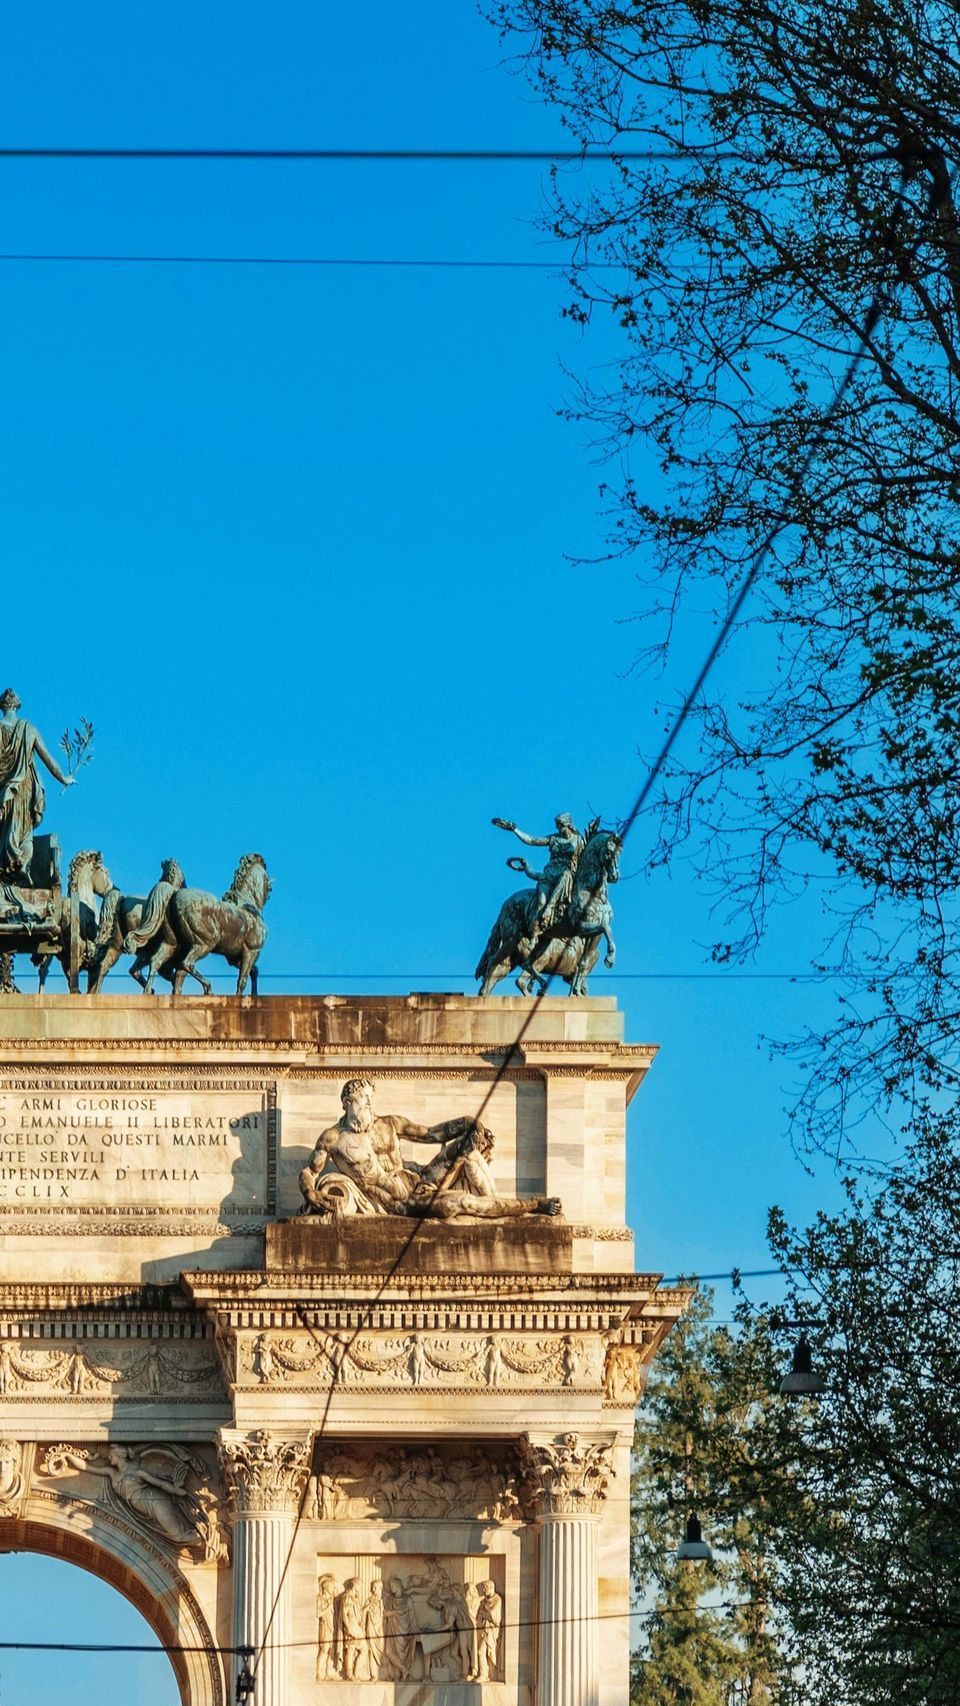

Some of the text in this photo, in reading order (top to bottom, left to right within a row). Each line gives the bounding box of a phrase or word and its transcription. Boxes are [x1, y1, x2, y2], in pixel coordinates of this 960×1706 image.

[20, 1098, 61, 1111] ARMI
[76, 1098, 158, 1111] GLORIOSE
[20, 1115, 113, 1129] EMANUELE
[127, 1115, 139, 1129] II
[153, 1115, 259, 1129] LIBERATORI
[67, 1133, 88, 1146] DA
[101, 1133, 160, 1147] QUESTI
[172, 1133, 228, 1146] MARMI
[40, 1150, 105, 1163] SERVILI
[141, 1167, 200, 1180] ITALIA
